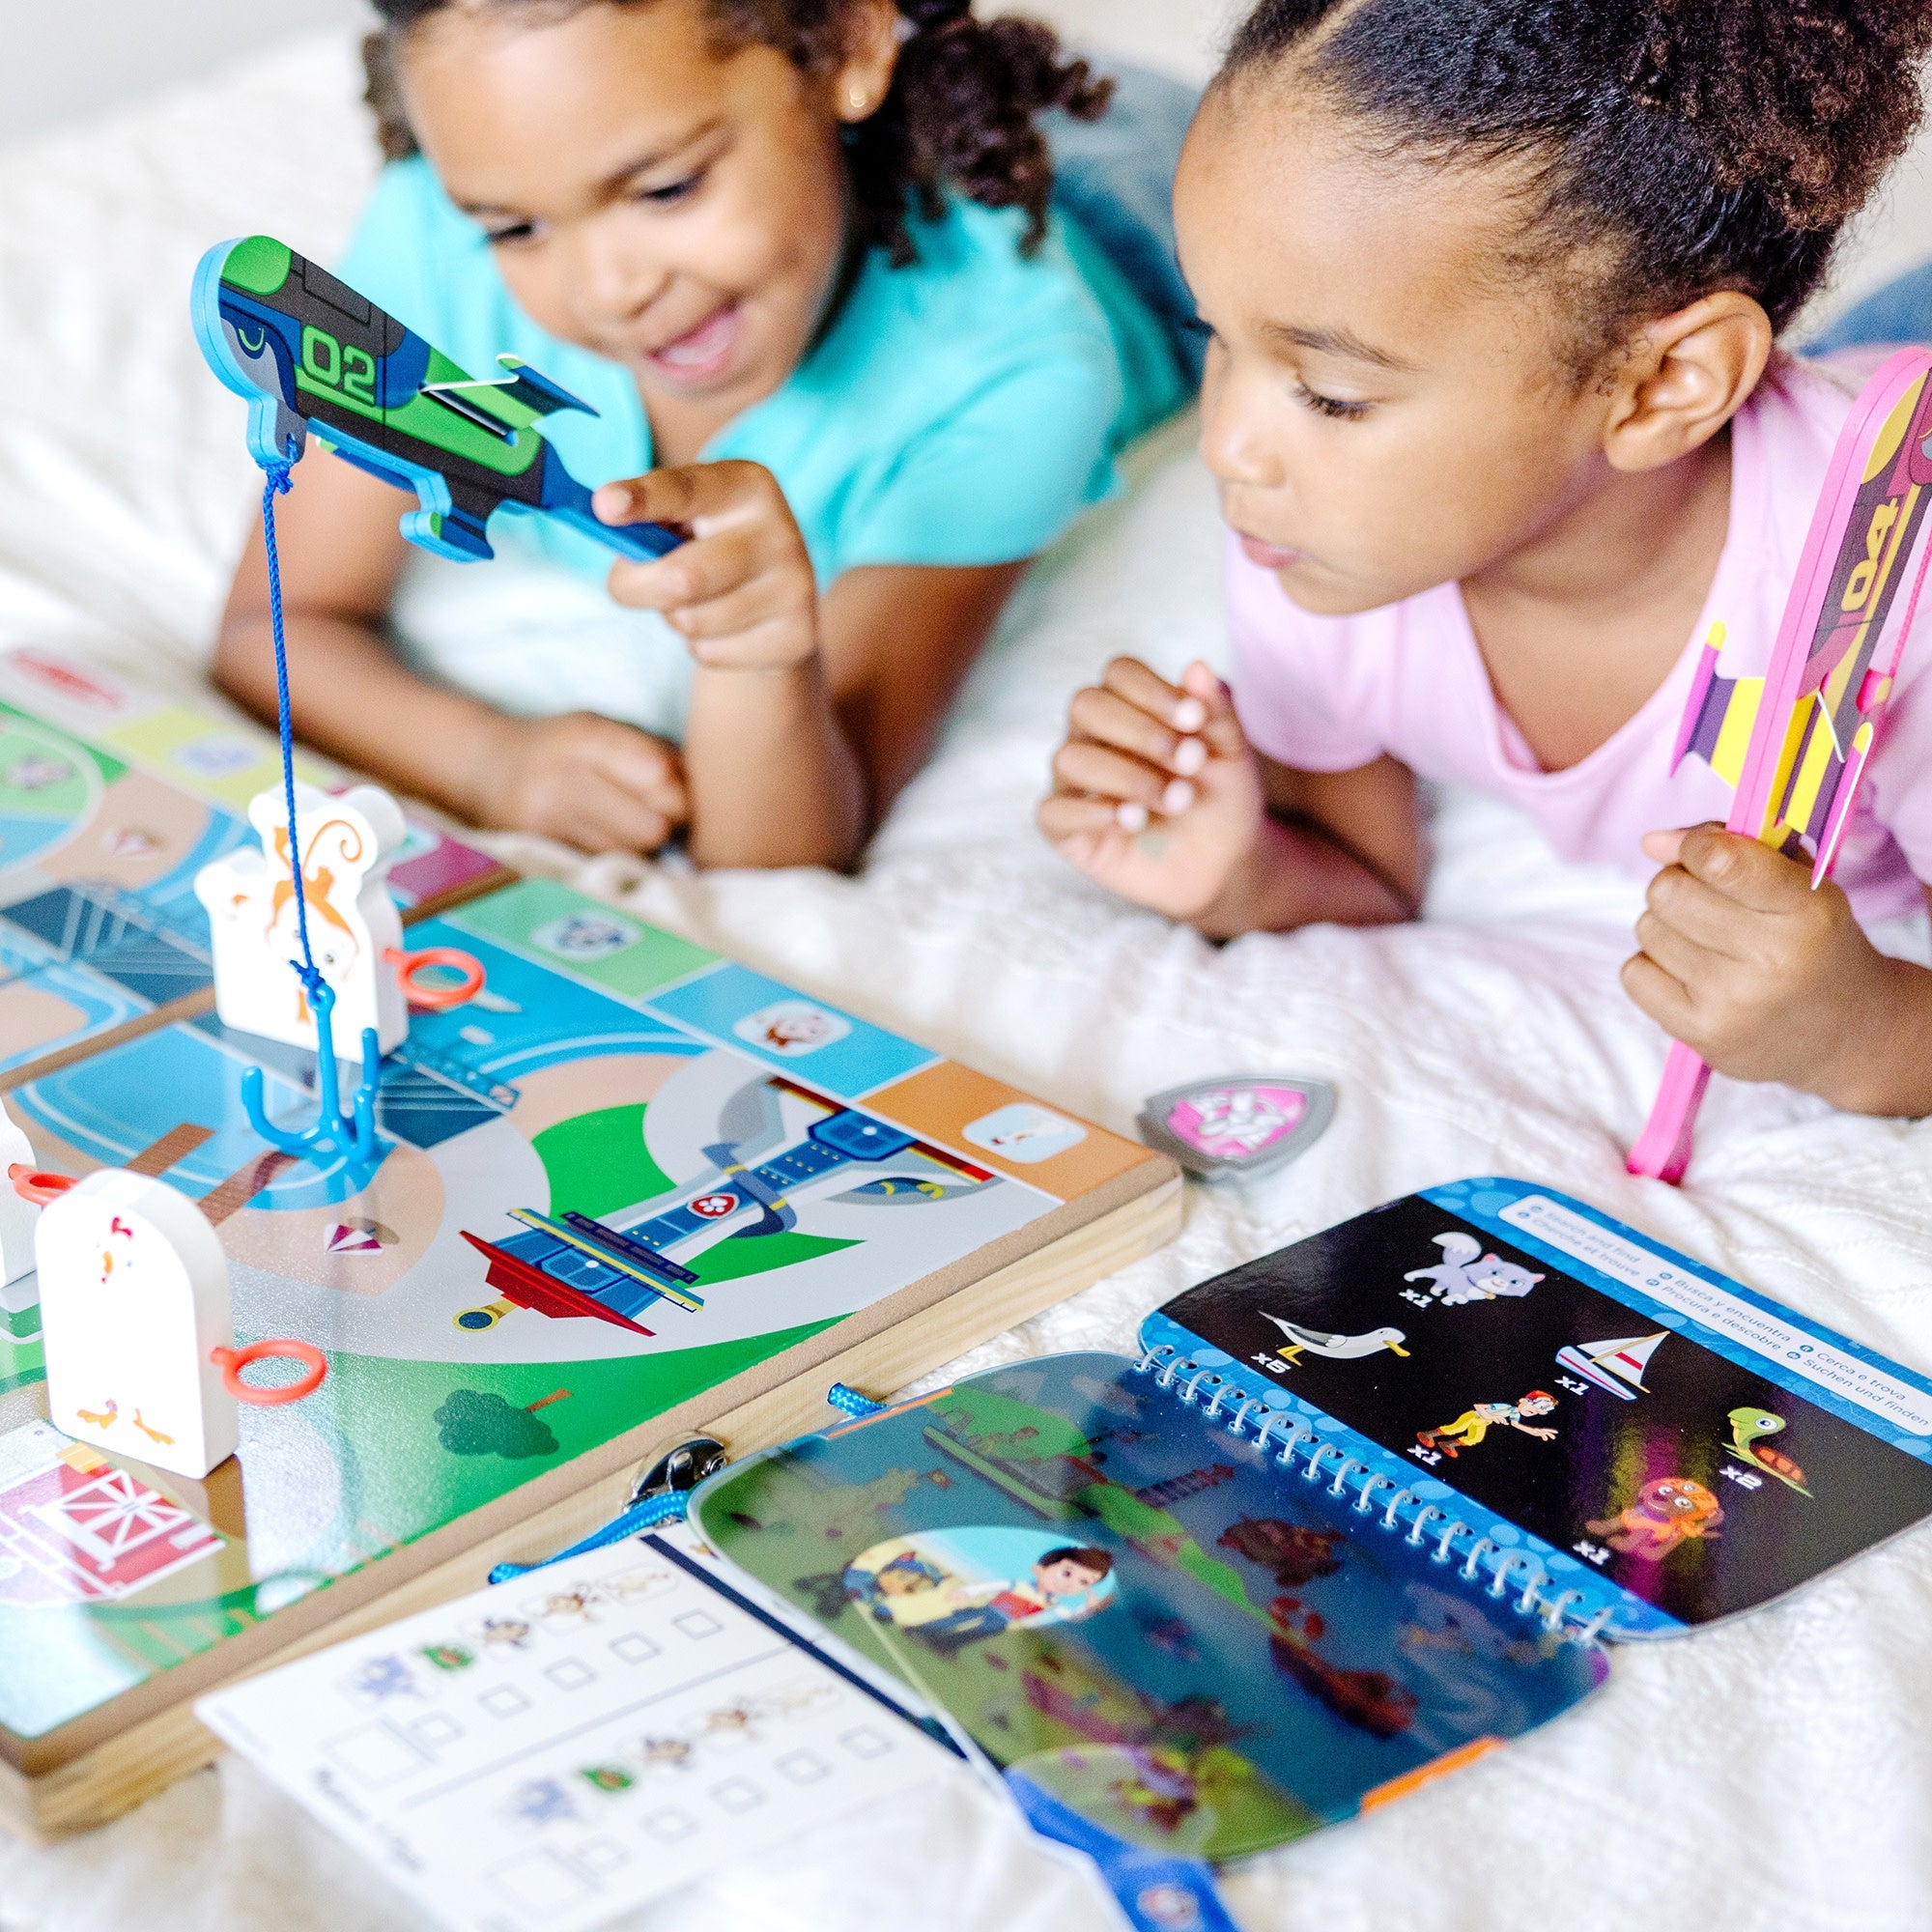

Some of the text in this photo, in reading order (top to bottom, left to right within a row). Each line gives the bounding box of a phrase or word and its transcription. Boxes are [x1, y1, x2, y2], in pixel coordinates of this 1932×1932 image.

[302, 325, 376, 406] 02
[1841, 497, 1899, 611] 04
[1399, 1289, 1434, 1308] x1
[1675, 1280, 1713, 1301] Busca
[1726, 1306, 1791, 1342] encuentra
[1662, 1286, 1710, 1313] Procura
[1722, 1317, 1781, 1350] descobre
[1250, 1352, 1292, 1374] x5
[1817, 1352, 1855, 1375] Cerca
[1870, 1379, 1906, 1401] trova
[1554, 1376, 1590, 1396] x1
[1804, 1359, 1929, 1426] Suchen und finden
[1406, 1444, 1442, 1466] x1
[1719, 1464, 1762, 1490] x2
[1573, 1541, 1610, 1565] x1
